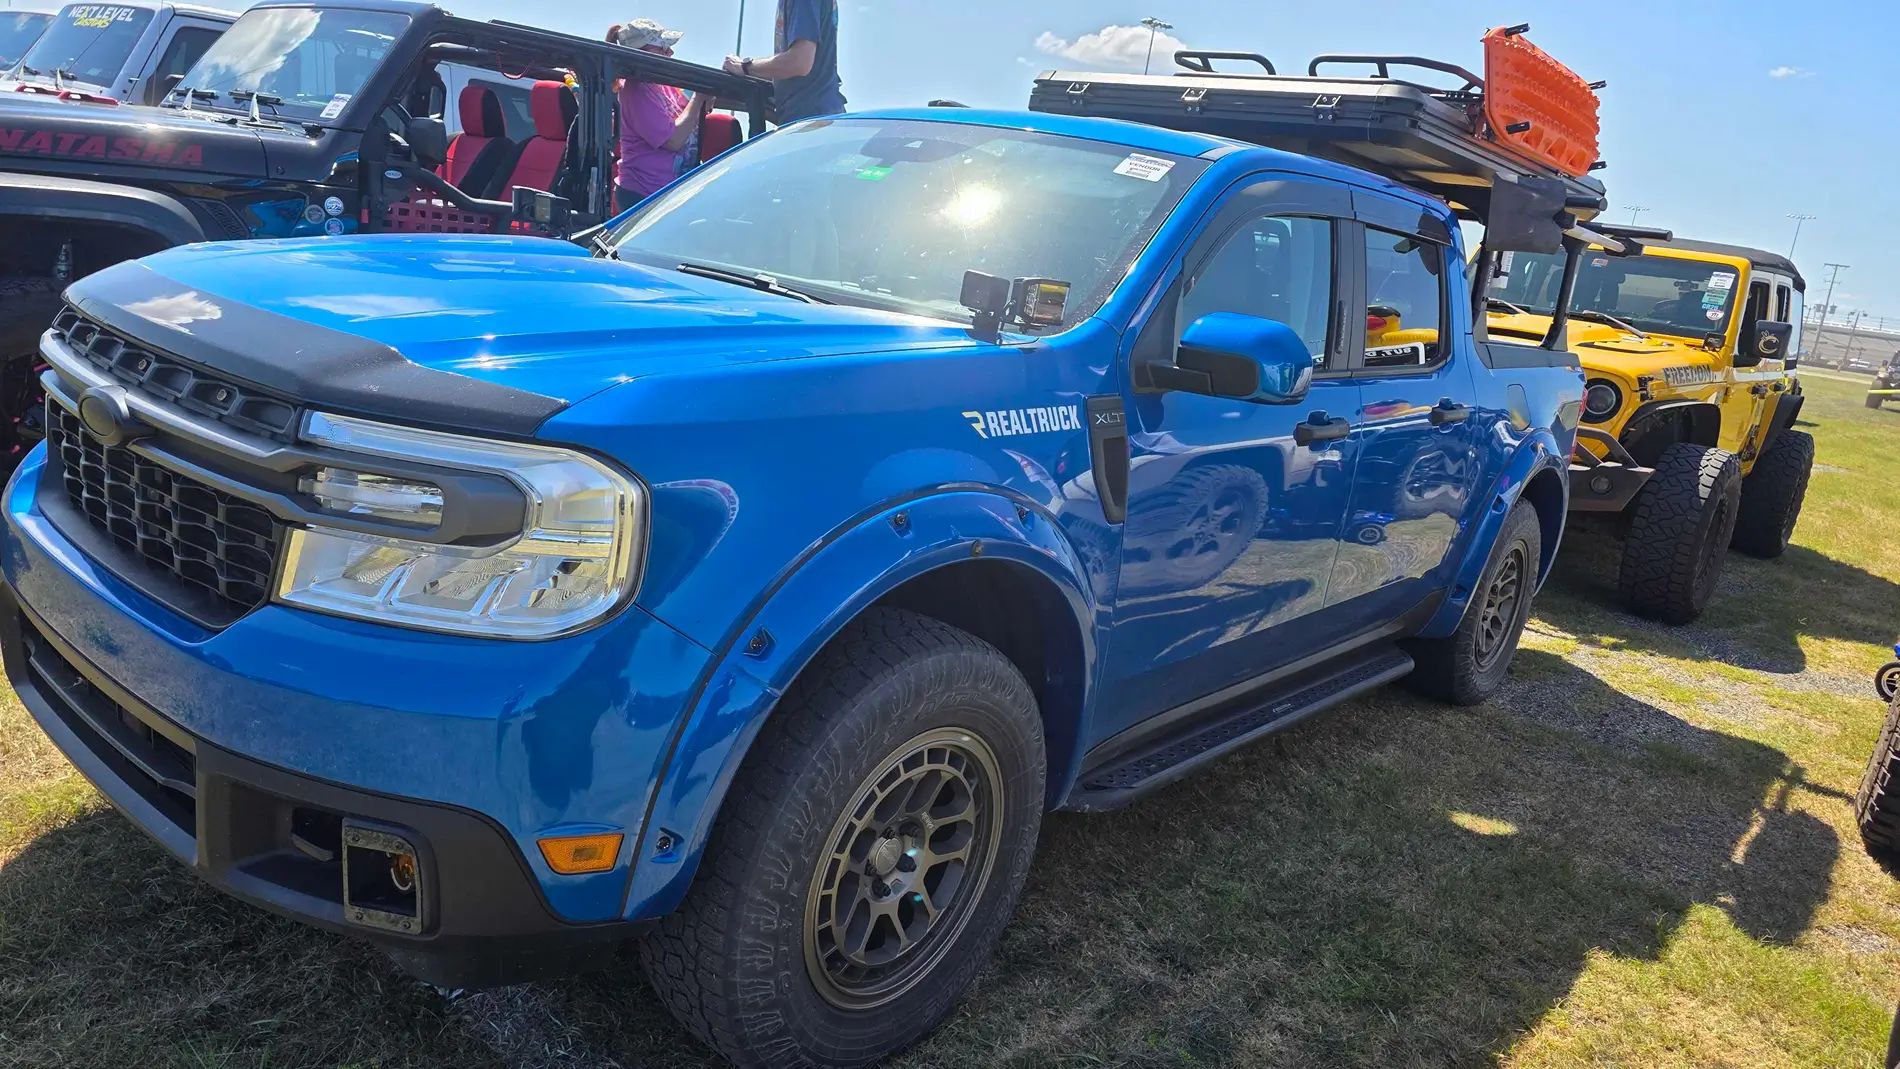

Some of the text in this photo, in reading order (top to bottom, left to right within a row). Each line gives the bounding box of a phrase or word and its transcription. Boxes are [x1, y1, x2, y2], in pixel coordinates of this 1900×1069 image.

[68, 5, 136, 22] NEXT LEVEL
[0, 128, 204, 166] NATASHA
[1129, 162, 1161, 172] VENDOR
[1663, 364, 1712, 386] FREEDOM
[985, 405, 1081, 437] REALTRUCK
[1095, 412, 1125, 425] XLT
